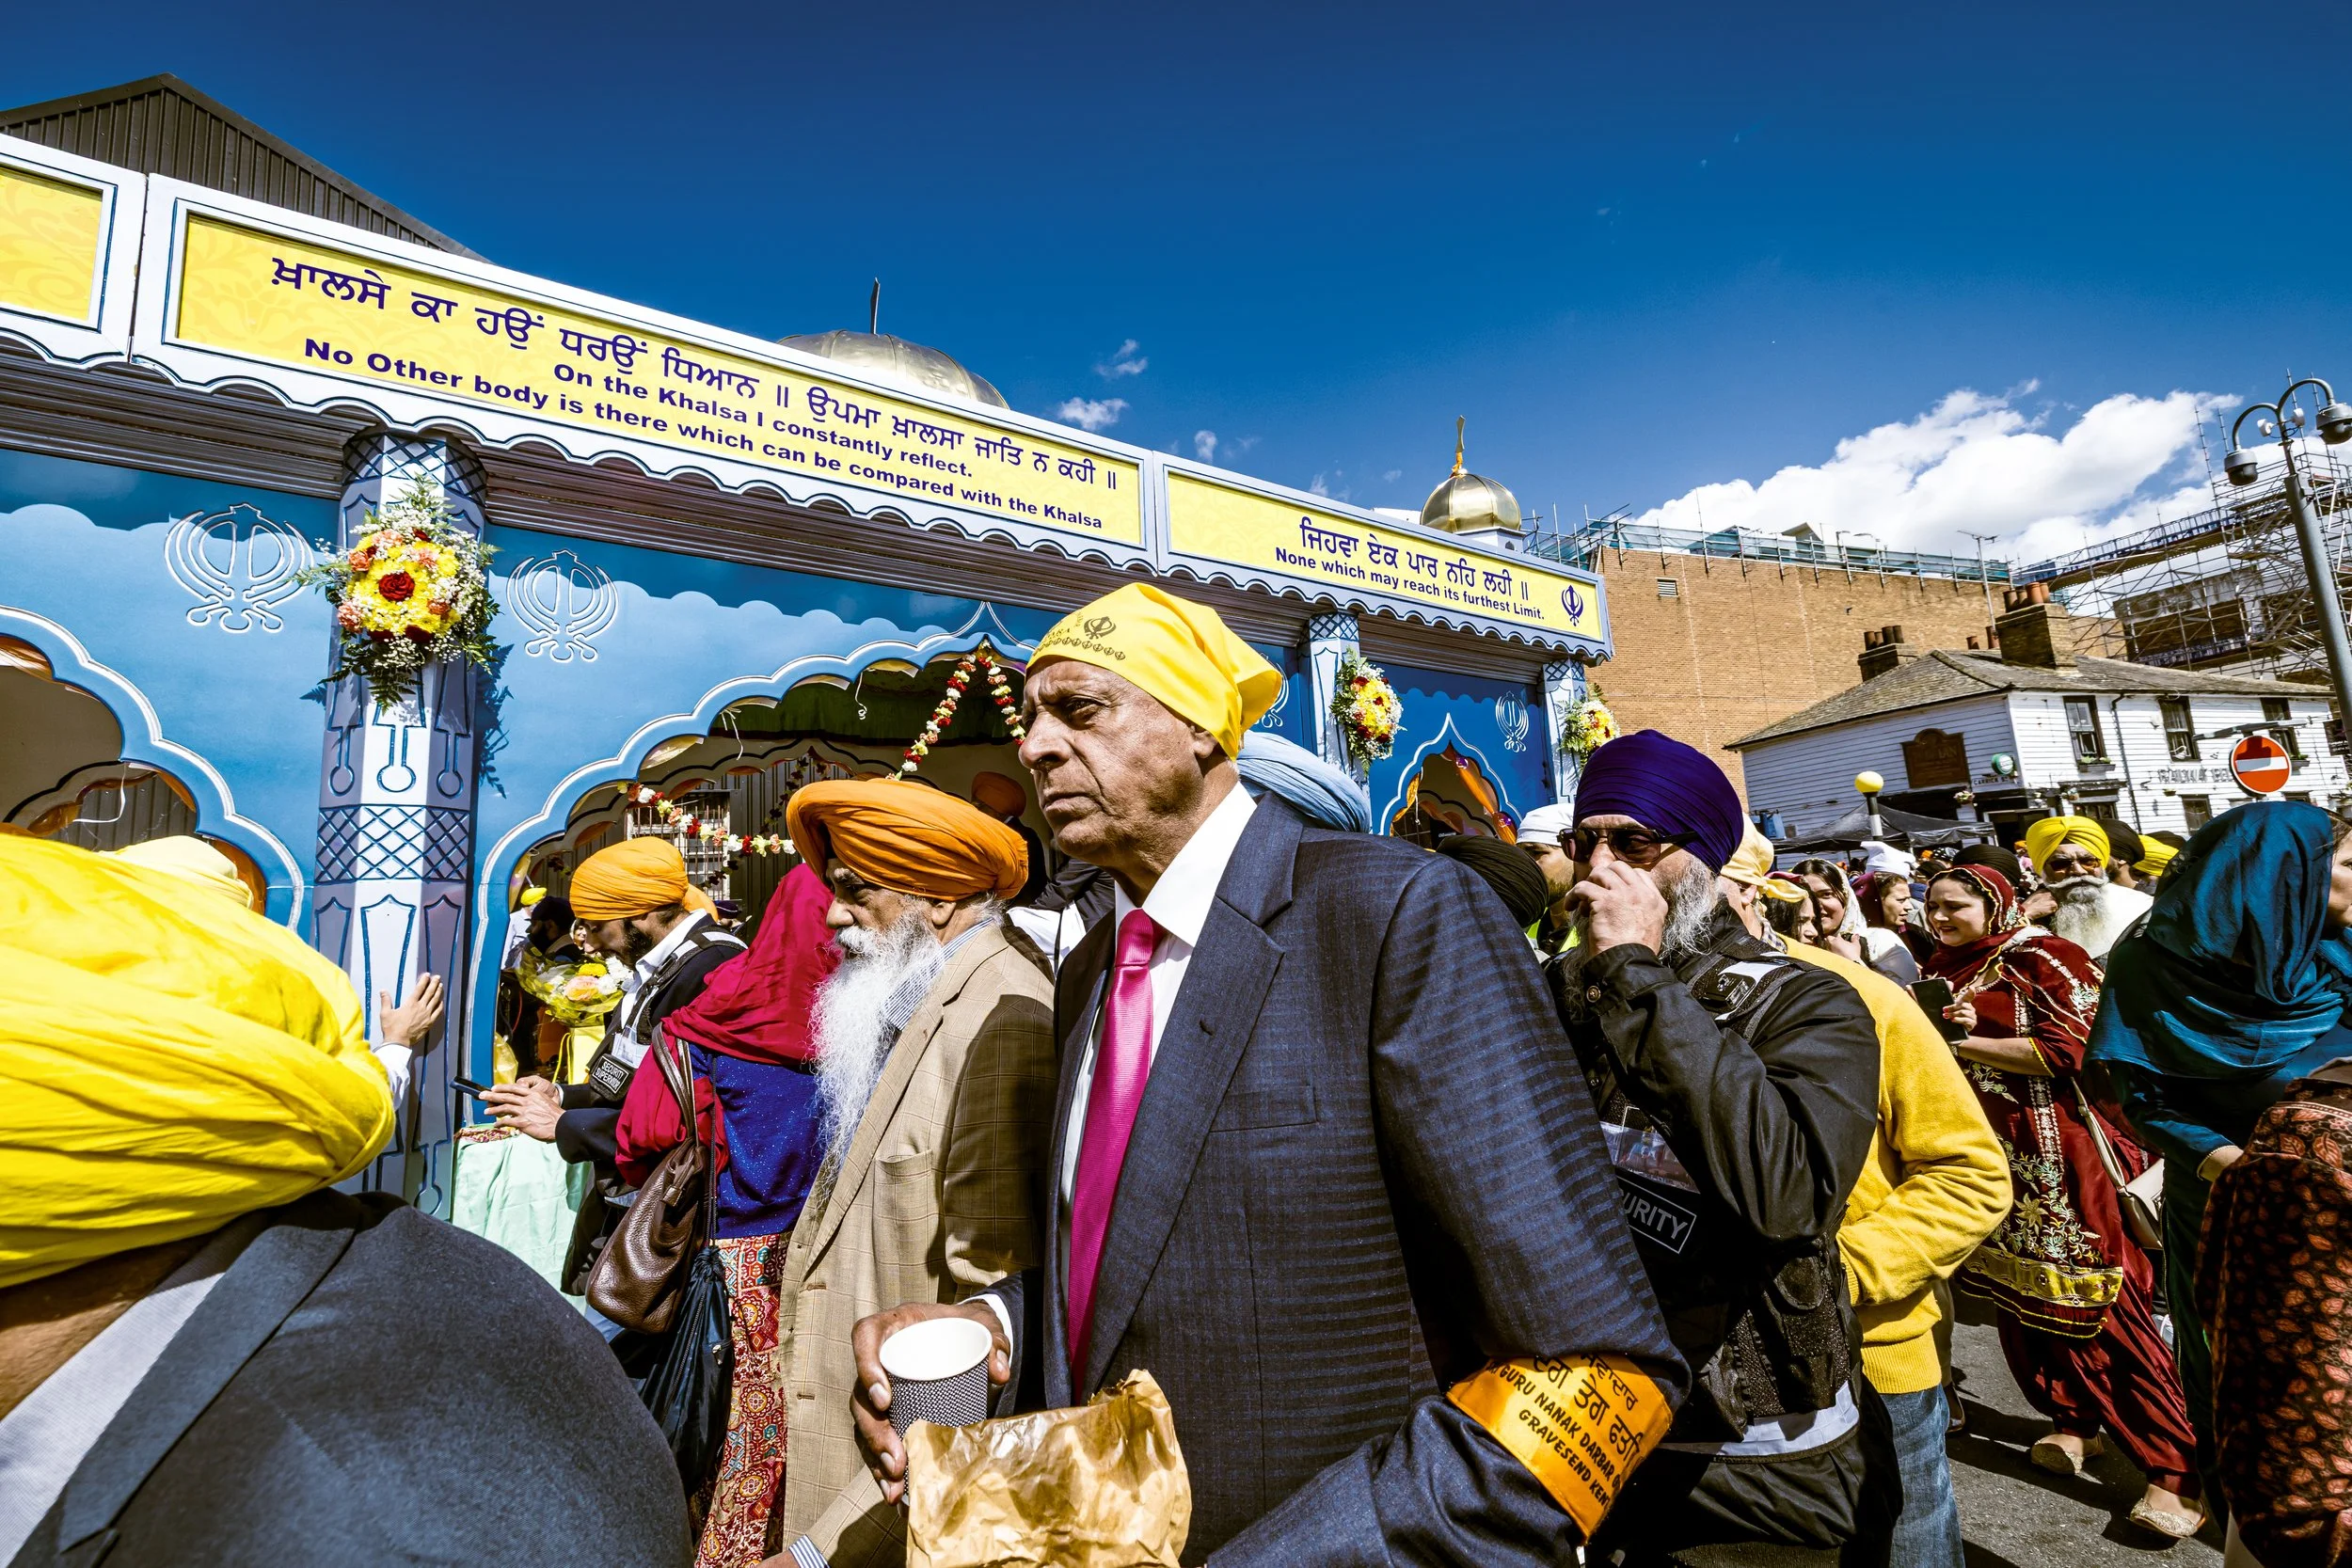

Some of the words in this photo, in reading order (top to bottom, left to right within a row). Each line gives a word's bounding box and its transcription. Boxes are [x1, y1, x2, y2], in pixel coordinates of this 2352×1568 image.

[305, 338, 354, 365] No
[367, 353, 464, 388] Other
[474, 374, 549, 410] body
[560, 393, 583, 414] is
[594, 402, 668, 432] there
[676, 423, 754, 451] which
[762, 443, 805, 464] can
[814, 451, 841, 471] be
[849, 464, 954, 498] compared
[961, 488, 1002, 508] with
[1008, 497, 1038, 515] the
[1043, 503, 1102, 529] Khalsa
[410, 291, 459, 324] ਕਾ
[660, 346, 760, 399] ਧਿਆਨ
[806, 387, 882, 429] ਉਪਮਾ
[974, 436, 1025, 467] ਜਾਤਿ
[1031, 451, 1050, 473] ਨ
[1057, 457, 1097, 484] ਕਹੀ
[553, 363, 593, 388] On
[603, 375, 648, 400] the
[659, 387, 747, 423] Khalsa
[757, 411, 763, 427] I
[772, 420, 893, 462] constantly
[900, 451, 973, 478] reflect.
[1275, 546, 1316, 569] None
[1321, 560, 1366, 580] which
[1370, 571, 1399, 590] may
[1403, 578, 1440, 597] reach
[1443, 587, 1460, 601] its
[1462, 590, 1511, 613] furthest
[1513, 602, 1545, 621] Limit.
[1298, 515, 1359, 559] ਜਿਹਵਾ
[1366, 532, 1399, 569] ਏਕ
[1406, 550, 1438, 578] ਪਾਰ
[1444, 557, 1476, 588] ਨਹਿ
[1482, 568, 1513, 596] ਲਹੀ
[1623, 1192, 1689, 1240] URITY
[1499, 1364, 1536, 1396] GURU
[1534, 1392, 1581, 1439] NANAK
[1580, 1432, 1615, 1482] DARBAR
[1518, 1408, 1592, 1482] GRAVESEND
